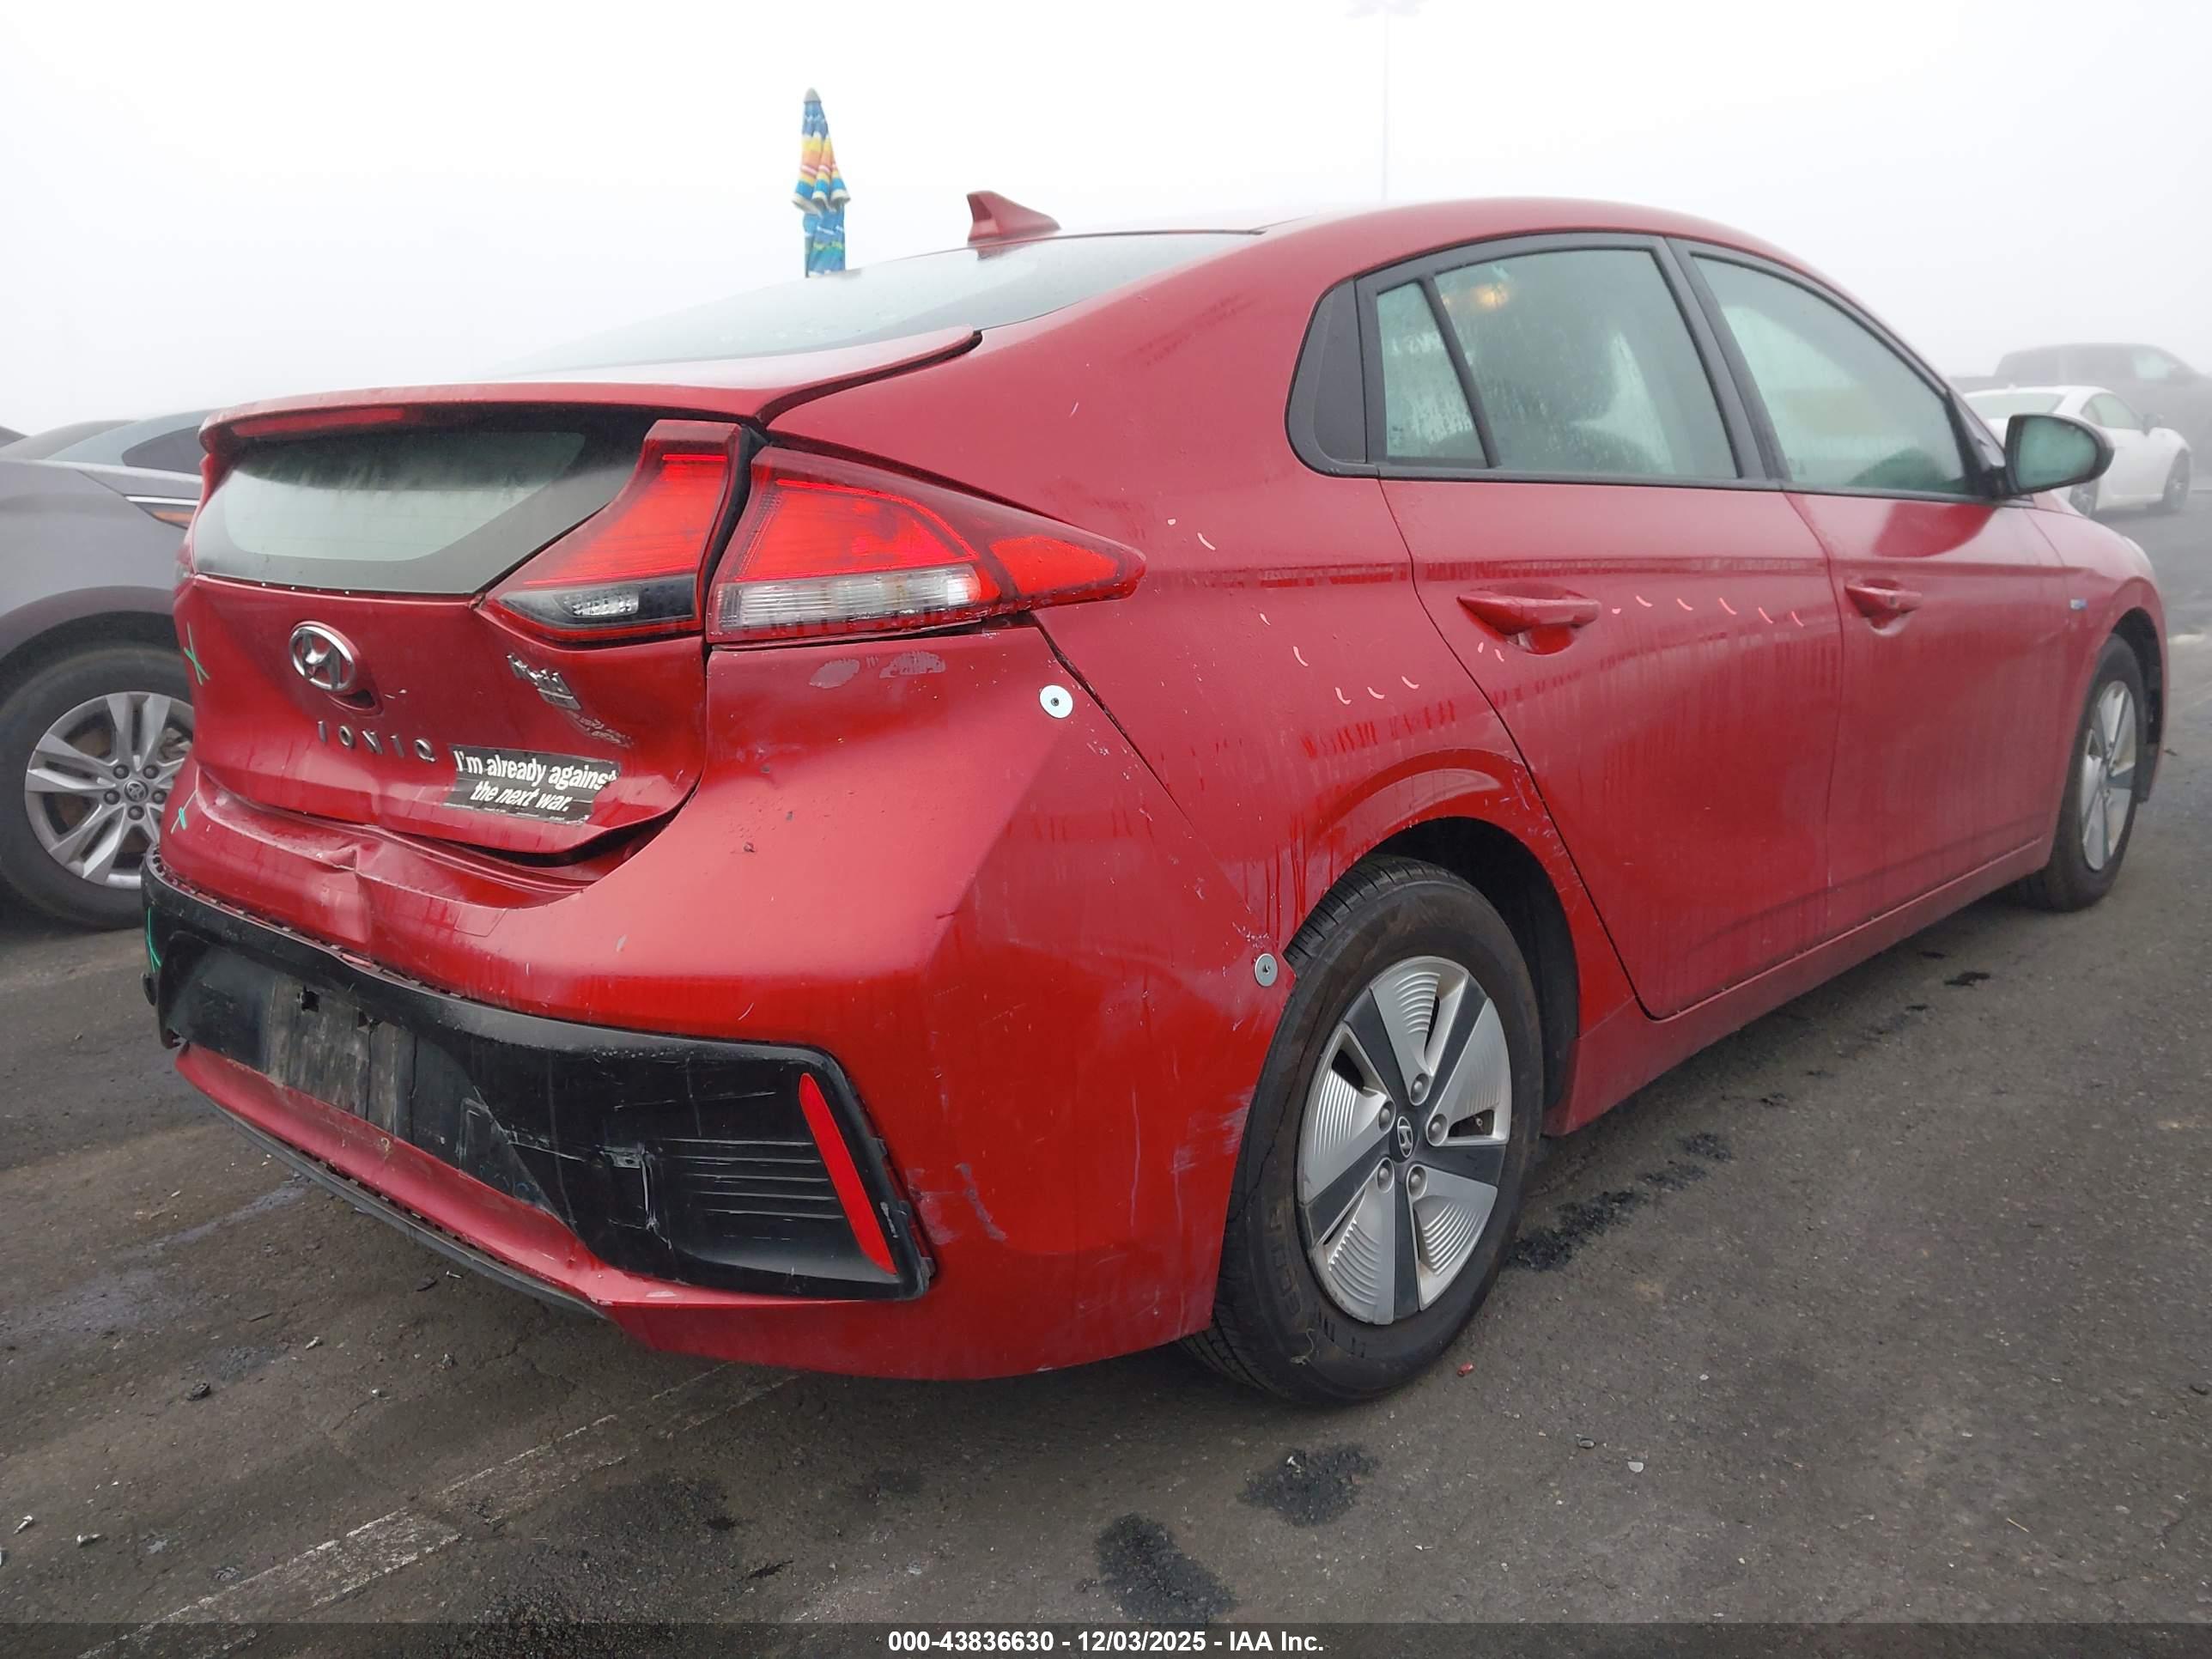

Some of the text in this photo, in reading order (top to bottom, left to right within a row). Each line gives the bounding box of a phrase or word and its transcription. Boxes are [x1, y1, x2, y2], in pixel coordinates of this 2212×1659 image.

[317, 720, 438, 763] IONIQ
[453, 750, 483, 775] I'm
[486, 754, 546, 787] already
[470, 781, 497, 801] the
[494, 787, 539, 807] next
[535, 792, 573, 812] war.
